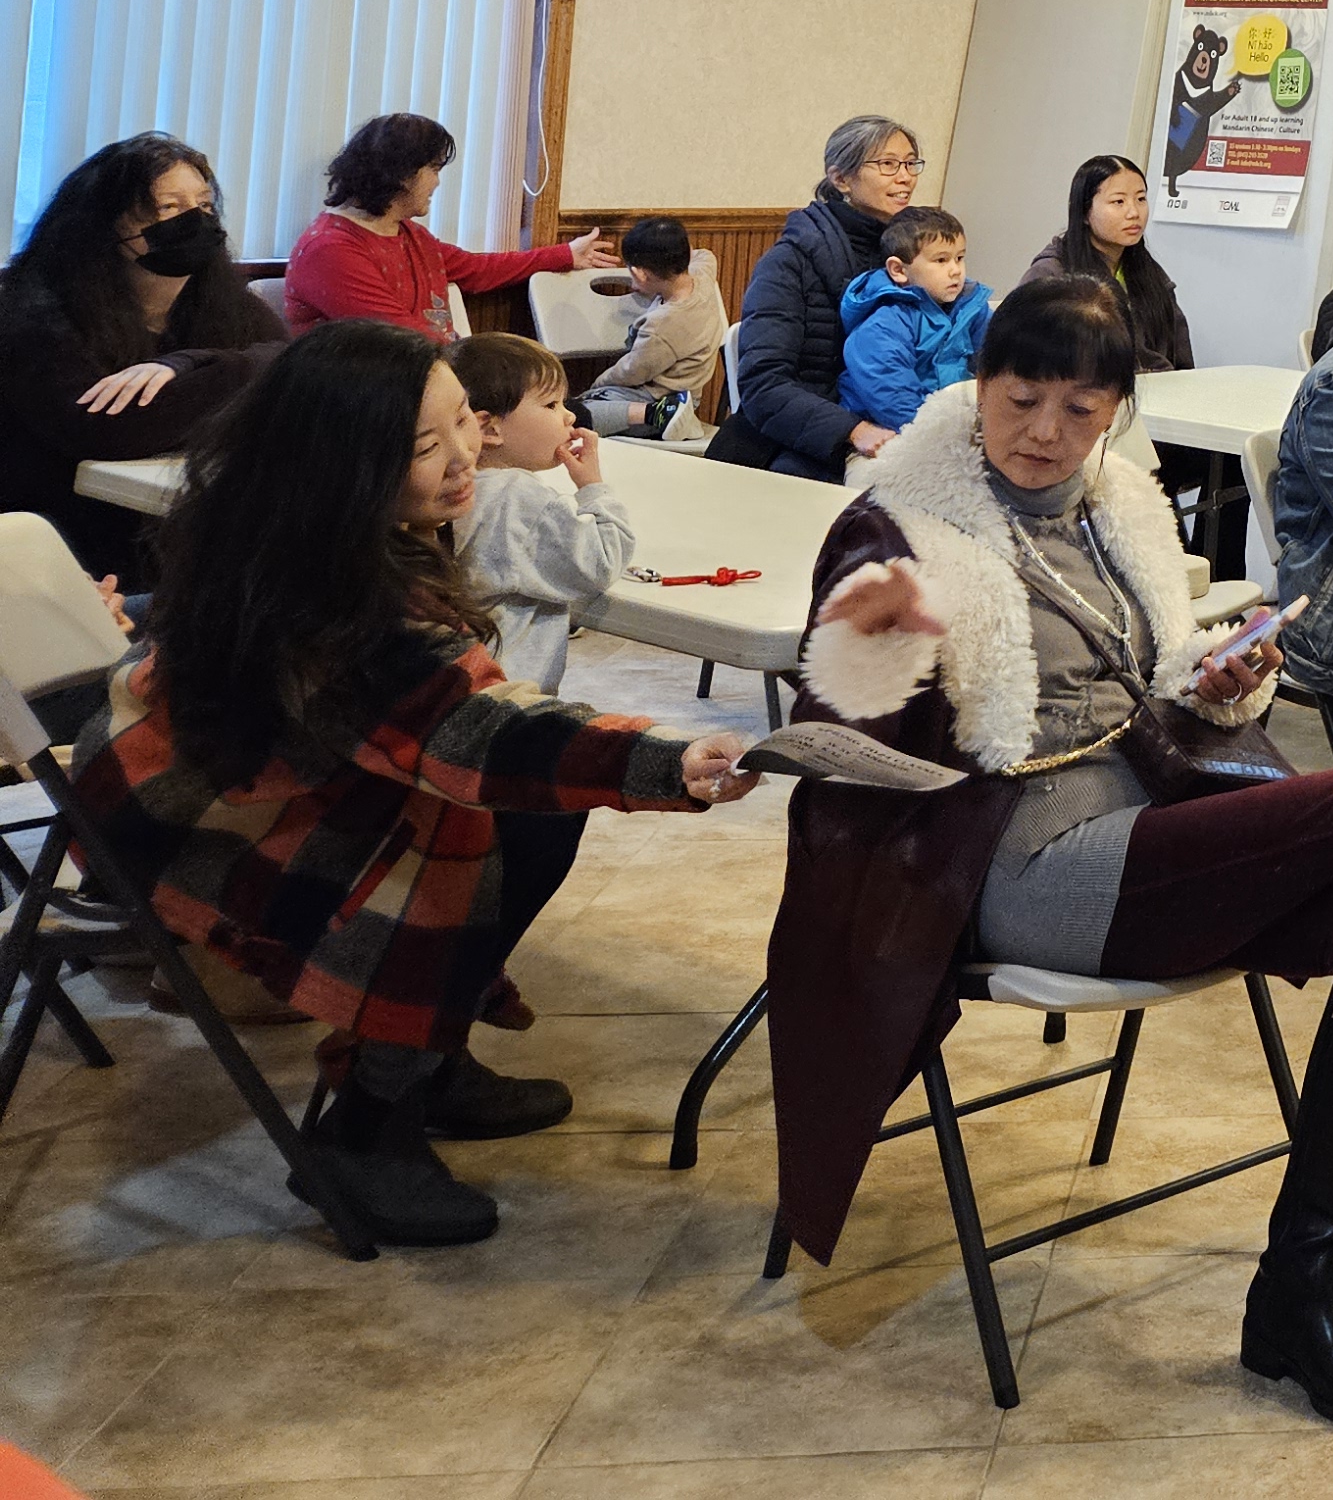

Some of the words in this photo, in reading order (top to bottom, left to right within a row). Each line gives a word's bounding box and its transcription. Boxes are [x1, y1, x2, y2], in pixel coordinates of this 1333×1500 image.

[1249, 52, 1269, 62] Hello
[1279, 116, 1304, 125] learning
[1251, 125, 1274, 133] Chinese
[1279, 126, 1300, 134] Culture
[1219, 200, 1240, 211] TCML
